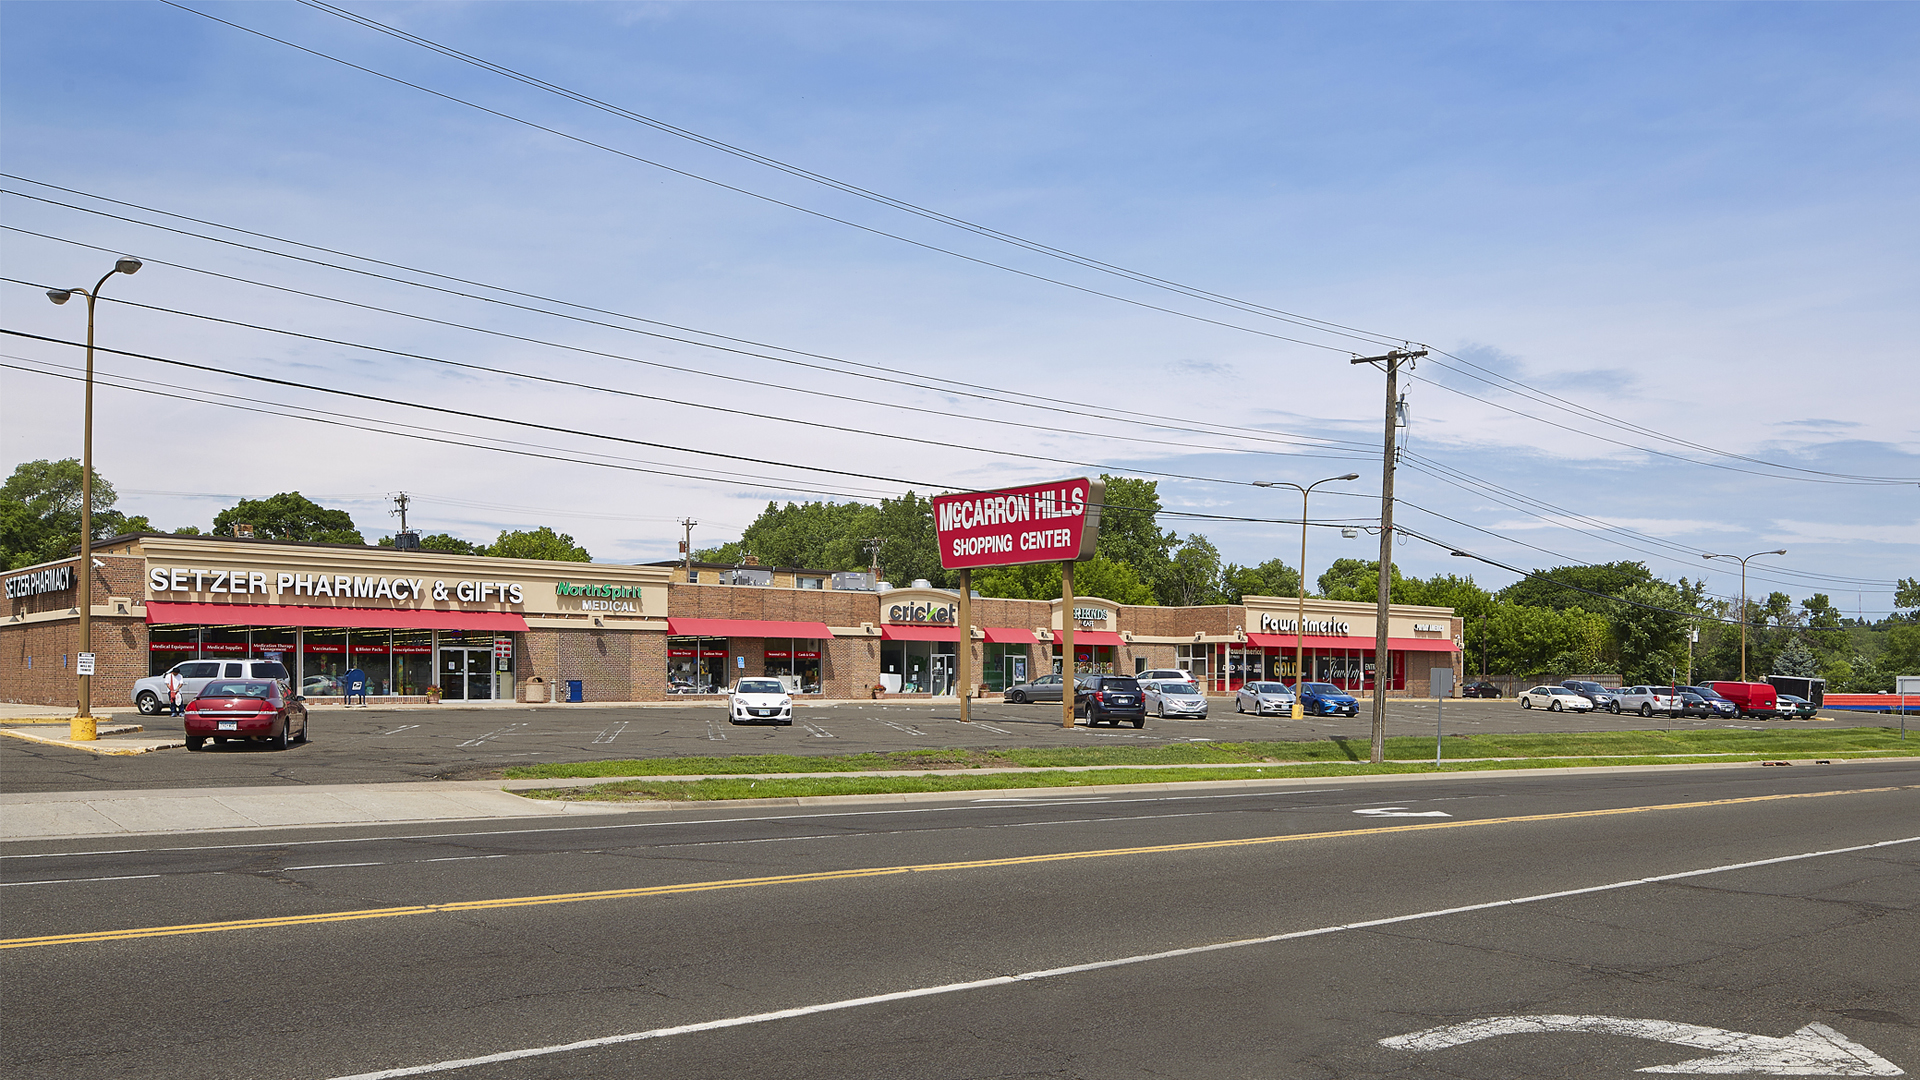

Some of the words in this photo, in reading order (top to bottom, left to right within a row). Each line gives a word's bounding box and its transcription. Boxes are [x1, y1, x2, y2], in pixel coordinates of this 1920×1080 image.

[1034, 486, 1085, 521] HILLS
[952, 533, 1013, 557] SHOPPING
[1019, 528, 1072, 551] CENTER
[5, 574, 30, 600] SETZER
[30, 566, 71, 596] PHARMACY
[149, 568, 268, 595] SETZER
[276, 572, 424, 600] PHARMACY
[432, 580, 450, 602] &
[456, 580, 524, 604] GIFTS
[556, 582, 642, 600] NorthSpirit
[582, 600, 636, 612] MEDICAL
[889, 601, 956, 623] cricket
